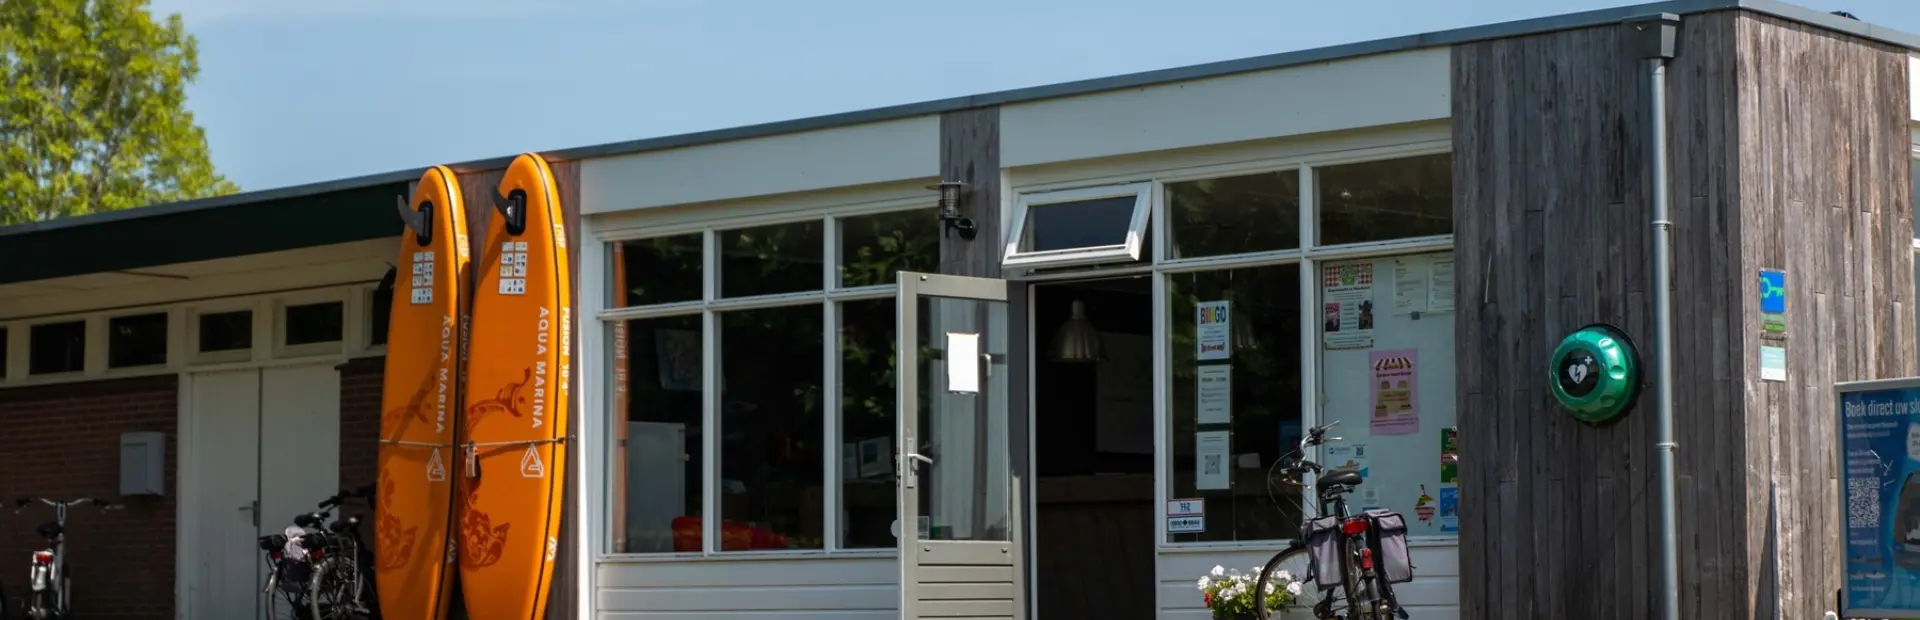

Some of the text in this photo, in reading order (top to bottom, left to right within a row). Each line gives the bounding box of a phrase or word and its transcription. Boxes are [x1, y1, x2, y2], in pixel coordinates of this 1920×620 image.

[562, 307, 570, 356] FUSION
[1200, 305, 1227, 324] BINGO
[436, 315, 452, 433] AQUA MARINA
[532, 306, 550, 429] AQUA MARINA
[1845, 401, 1867, 418] Boek
[1868, 400, 1893, 416] direct
[1895, 402, 1908, 415] uw
